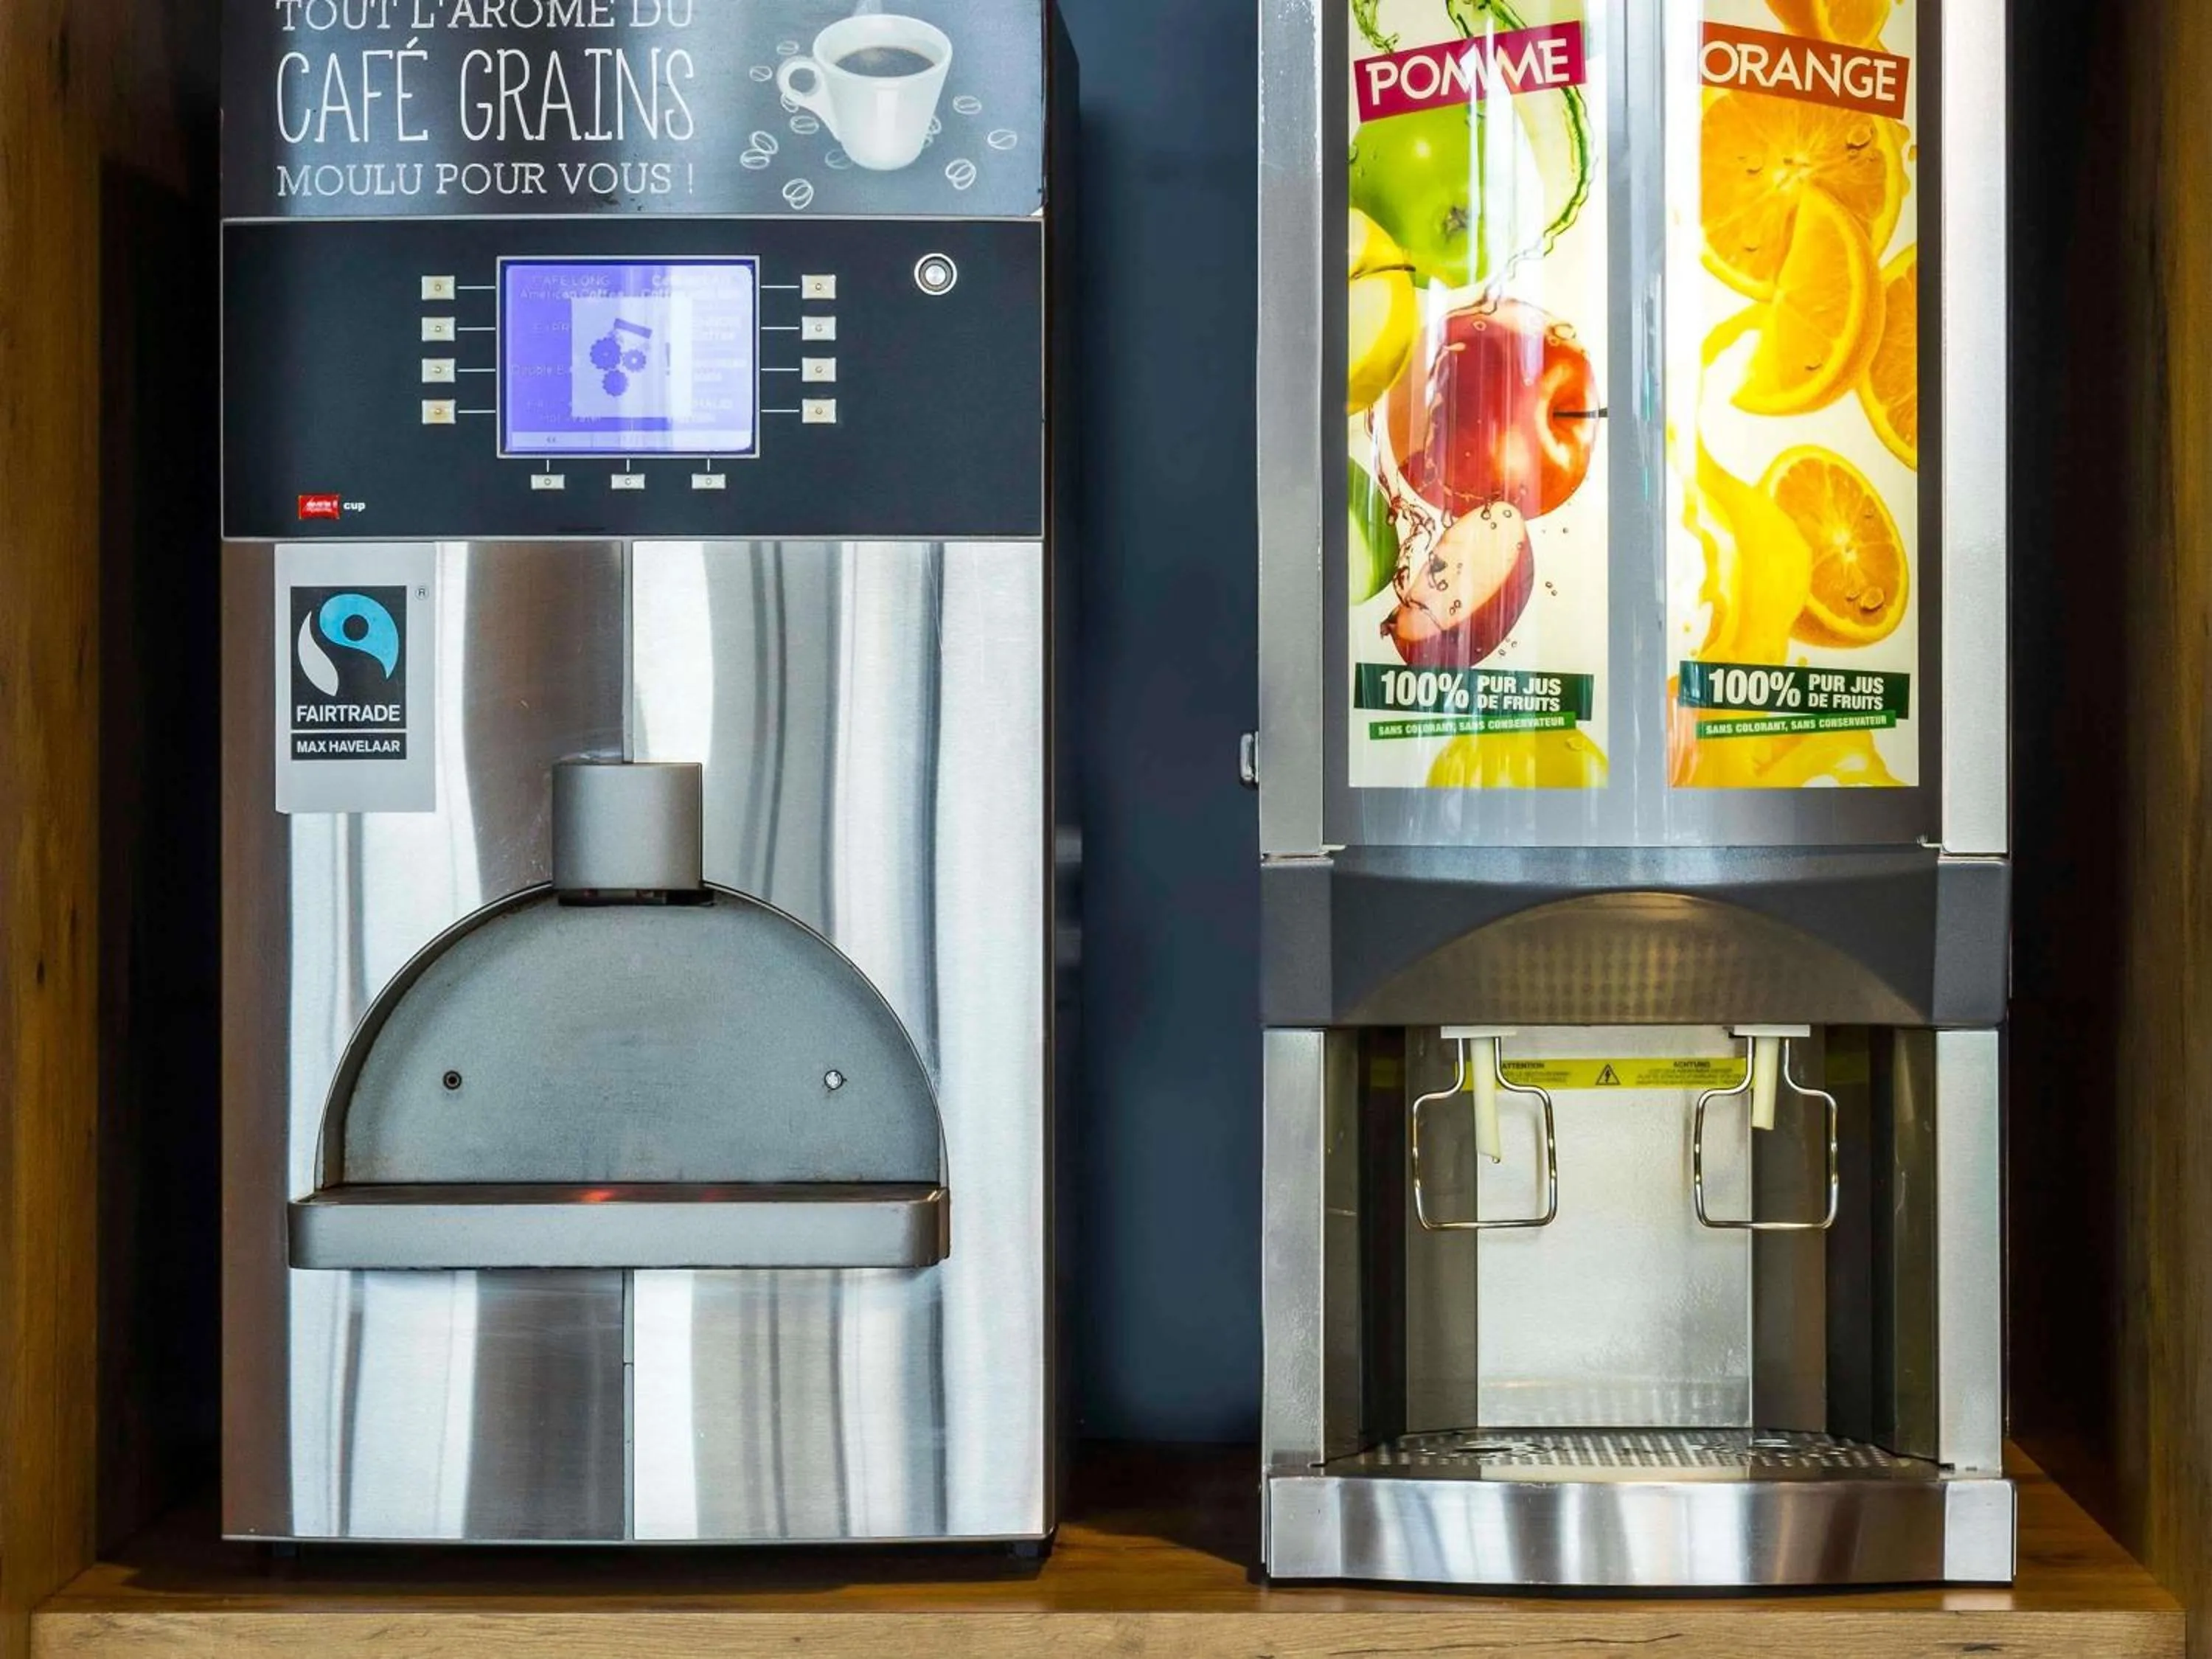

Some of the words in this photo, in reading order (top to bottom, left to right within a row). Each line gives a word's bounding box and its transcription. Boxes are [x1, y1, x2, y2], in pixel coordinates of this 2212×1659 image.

[276, 0, 397, 31] TOUT
[630, 0, 692, 28] DU
[1365, 38, 1570, 105] POMME
[1698, 41, 1898, 102] ORANGE
[276, 36, 428, 144] CAFÉ
[459, 48, 695, 142] GRAINS
[276, 164, 423, 197] MOULU
[436, 162, 547, 195] POUR
[558, 162, 672, 195] VOUS
[344, 502, 366, 512] cup
[1381, 669, 1470, 709] 100%
[1477, 675, 1517, 693] PUR
[1523, 677, 1562, 696] JUS
[1708, 668, 1801, 708] 100%
[1808, 673, 1846, 692] PUR
[1850, 675, 1884, 695] JUS
[296, 705, 401, 722] FAIRTRADE
[1477, 694, 1498, 709] DE
[1503, 695, 1561, 712] FRUITS
[1808, 694, 1828, 708] DE
[1833, 694, 1883, 711] FRUITS
[1378, 726, 1402, 736] SANS
[1458, 719, 1485, 730] SANS
[1487, 716, 1565, 731] CONSERVATEUR
[1705, 725, 1733, 735] SANS
[1736, 721, 1789, 734] COLORANT,
[1791, 718, 1816, 730] SANS
[1819, 714, 1887, 728] CONSERVATEUR
[296, 740, 326, 753] MAX
[329, 740, 400, 753] HAVELAAR
